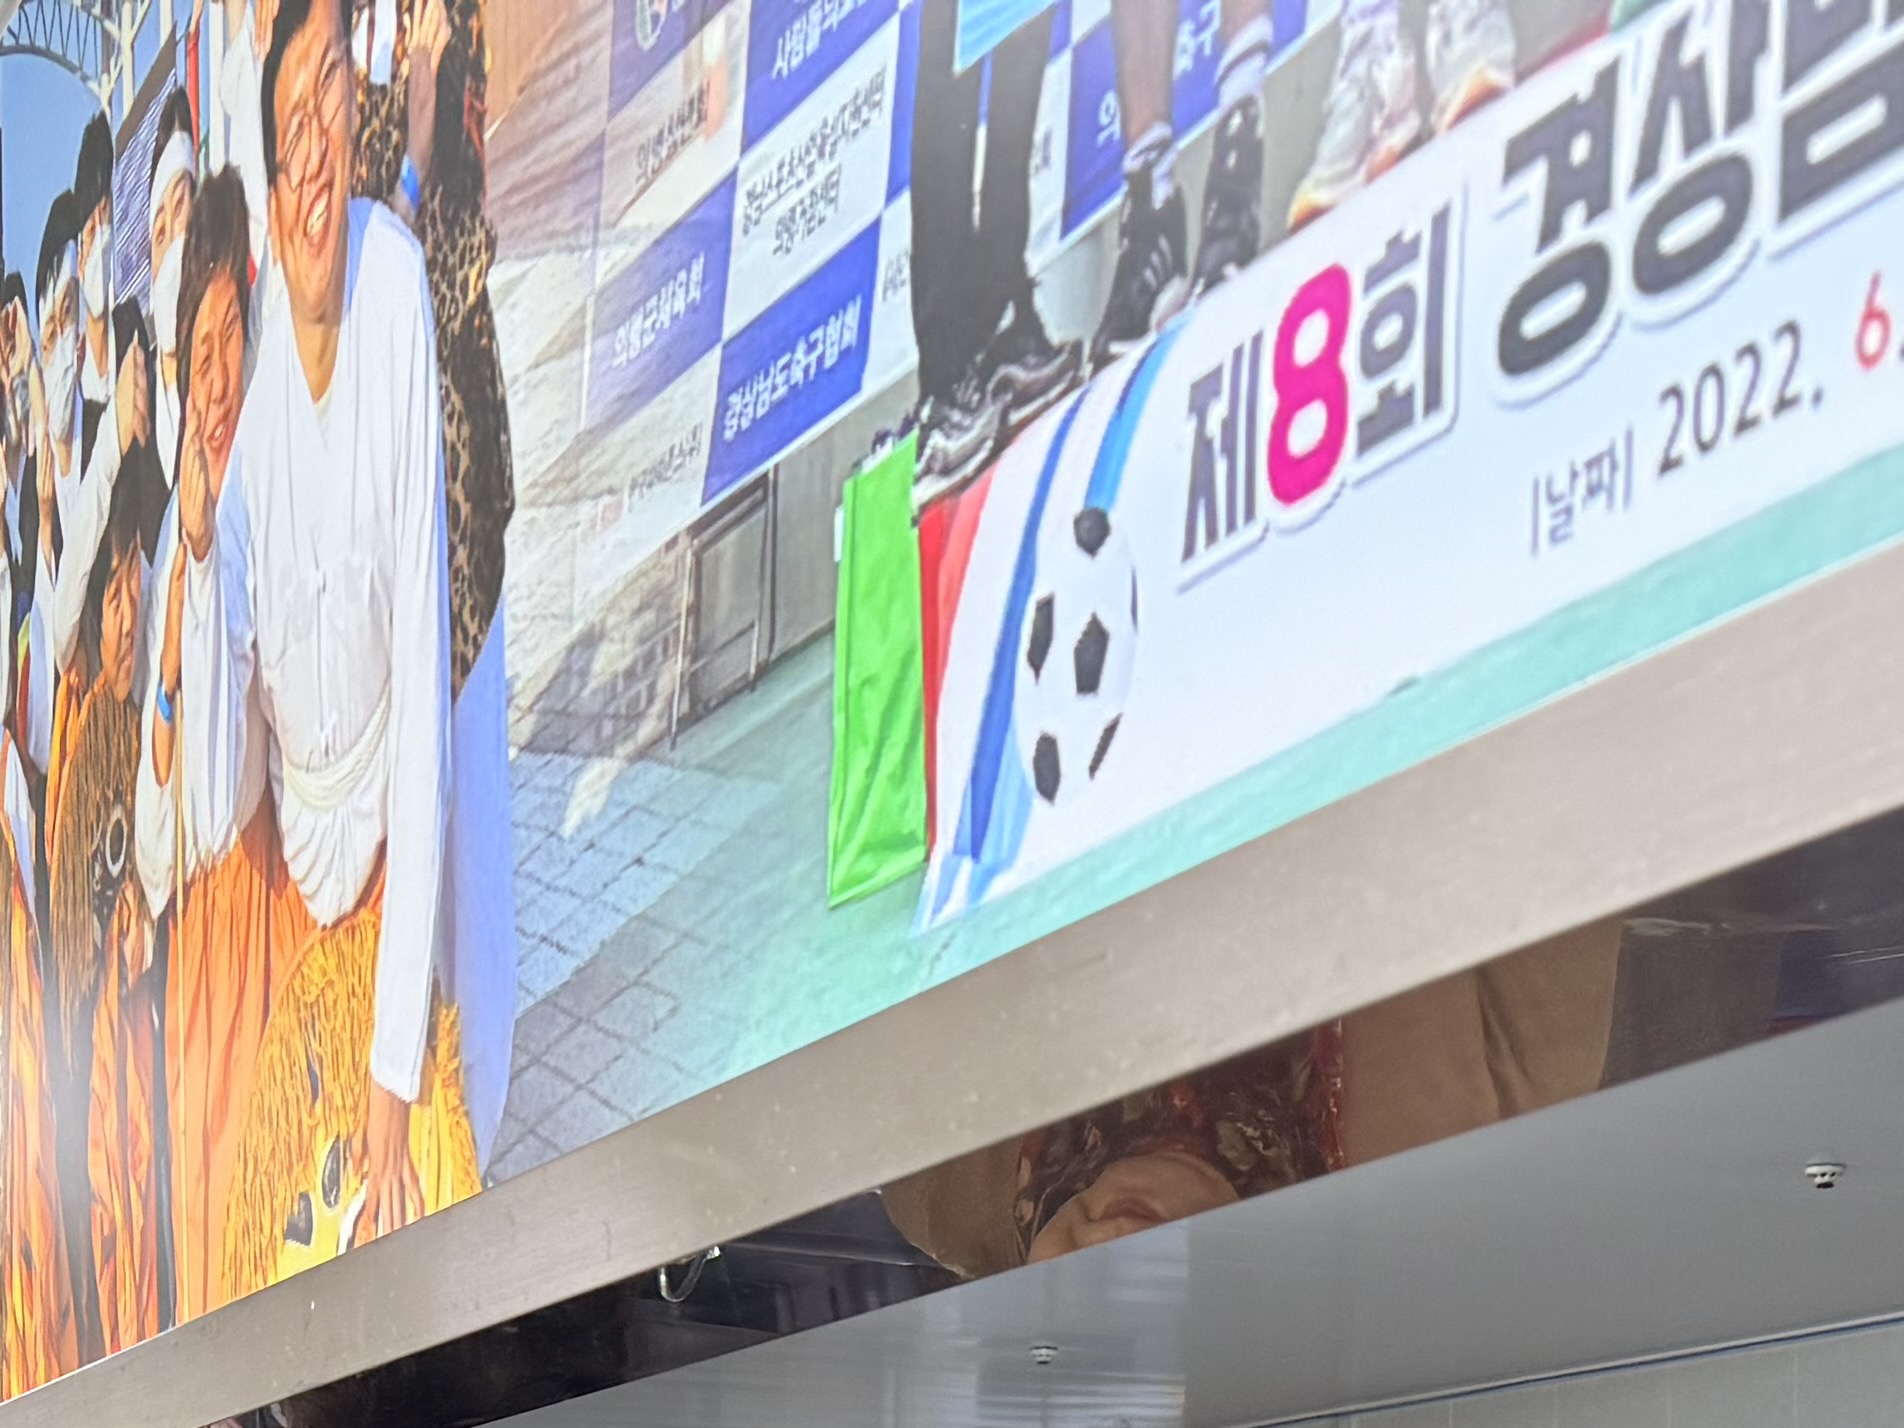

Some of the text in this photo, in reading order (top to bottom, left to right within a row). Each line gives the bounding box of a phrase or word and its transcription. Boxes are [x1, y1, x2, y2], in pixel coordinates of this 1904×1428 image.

[723, 293, 862, 442] 경상남도축구협회
[1183, 202, 1450, 565] 제8회
[1656, 322, 1824, 477] 2022.
